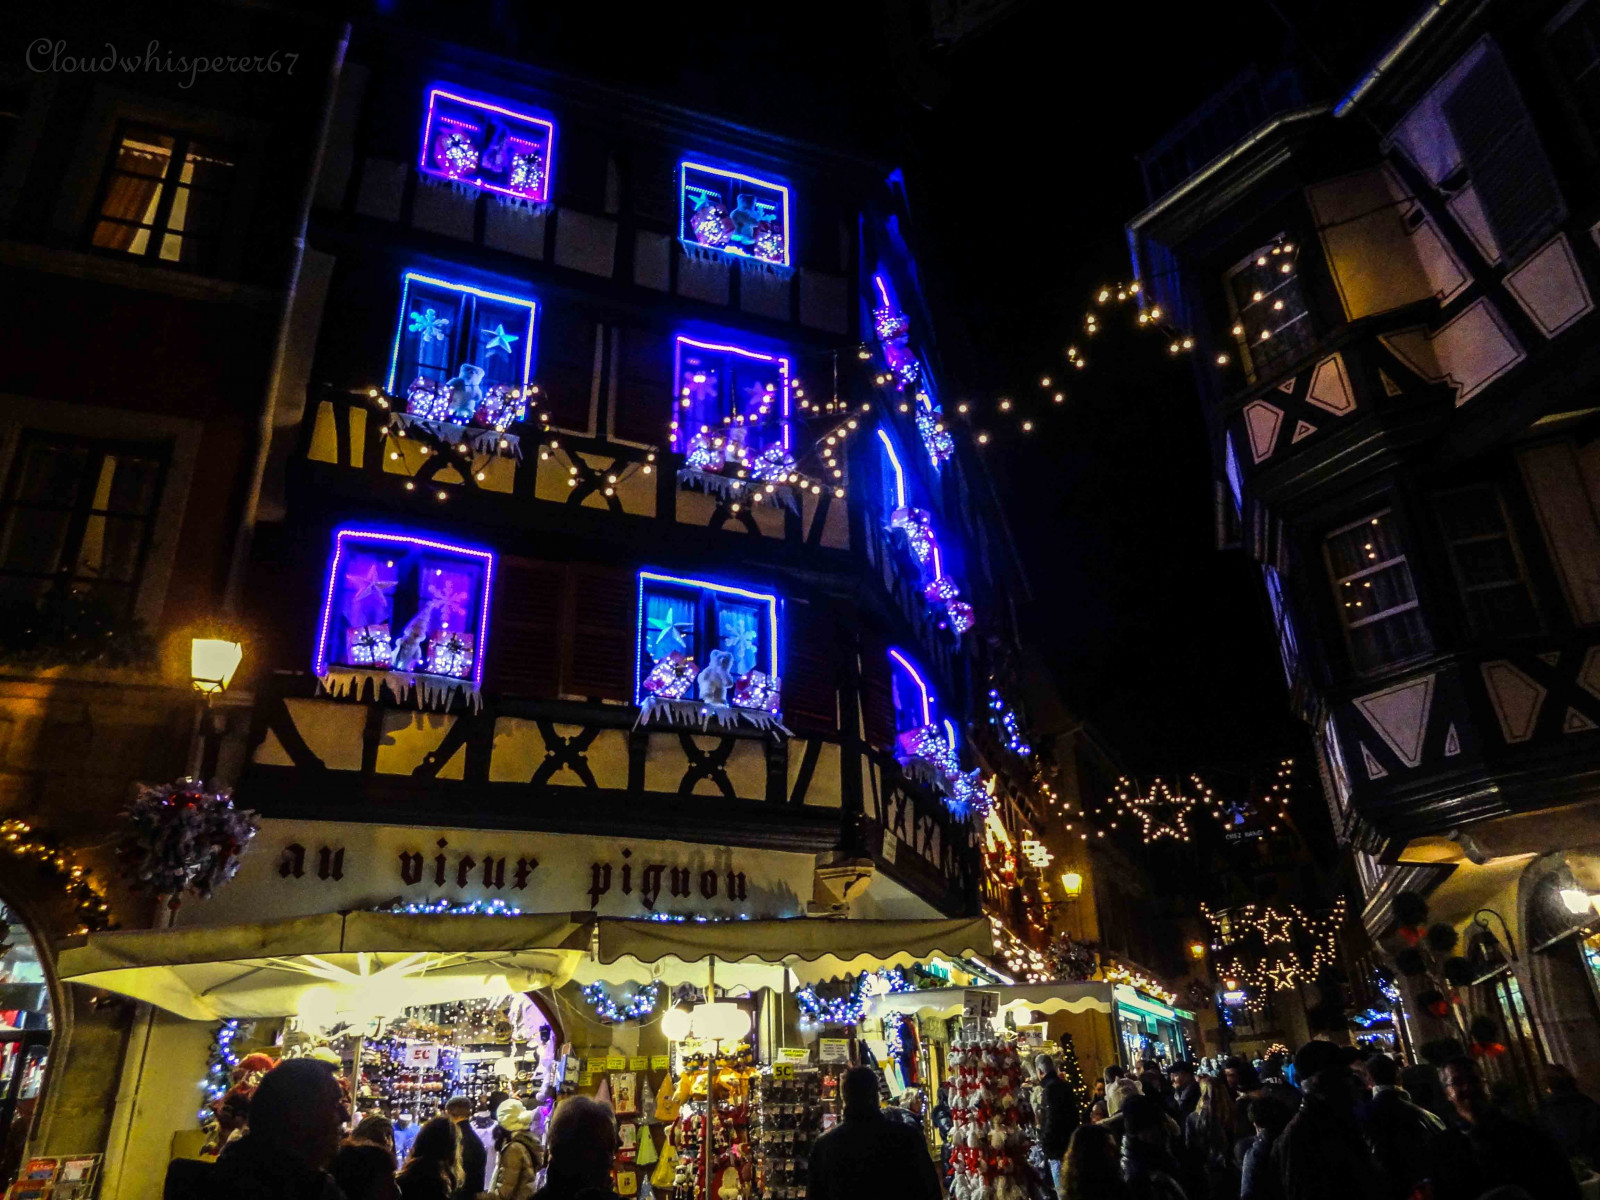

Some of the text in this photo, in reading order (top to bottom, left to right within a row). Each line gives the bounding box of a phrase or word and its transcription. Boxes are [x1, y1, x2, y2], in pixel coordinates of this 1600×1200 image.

[278, 836, 748, 911] au vieux pignon
